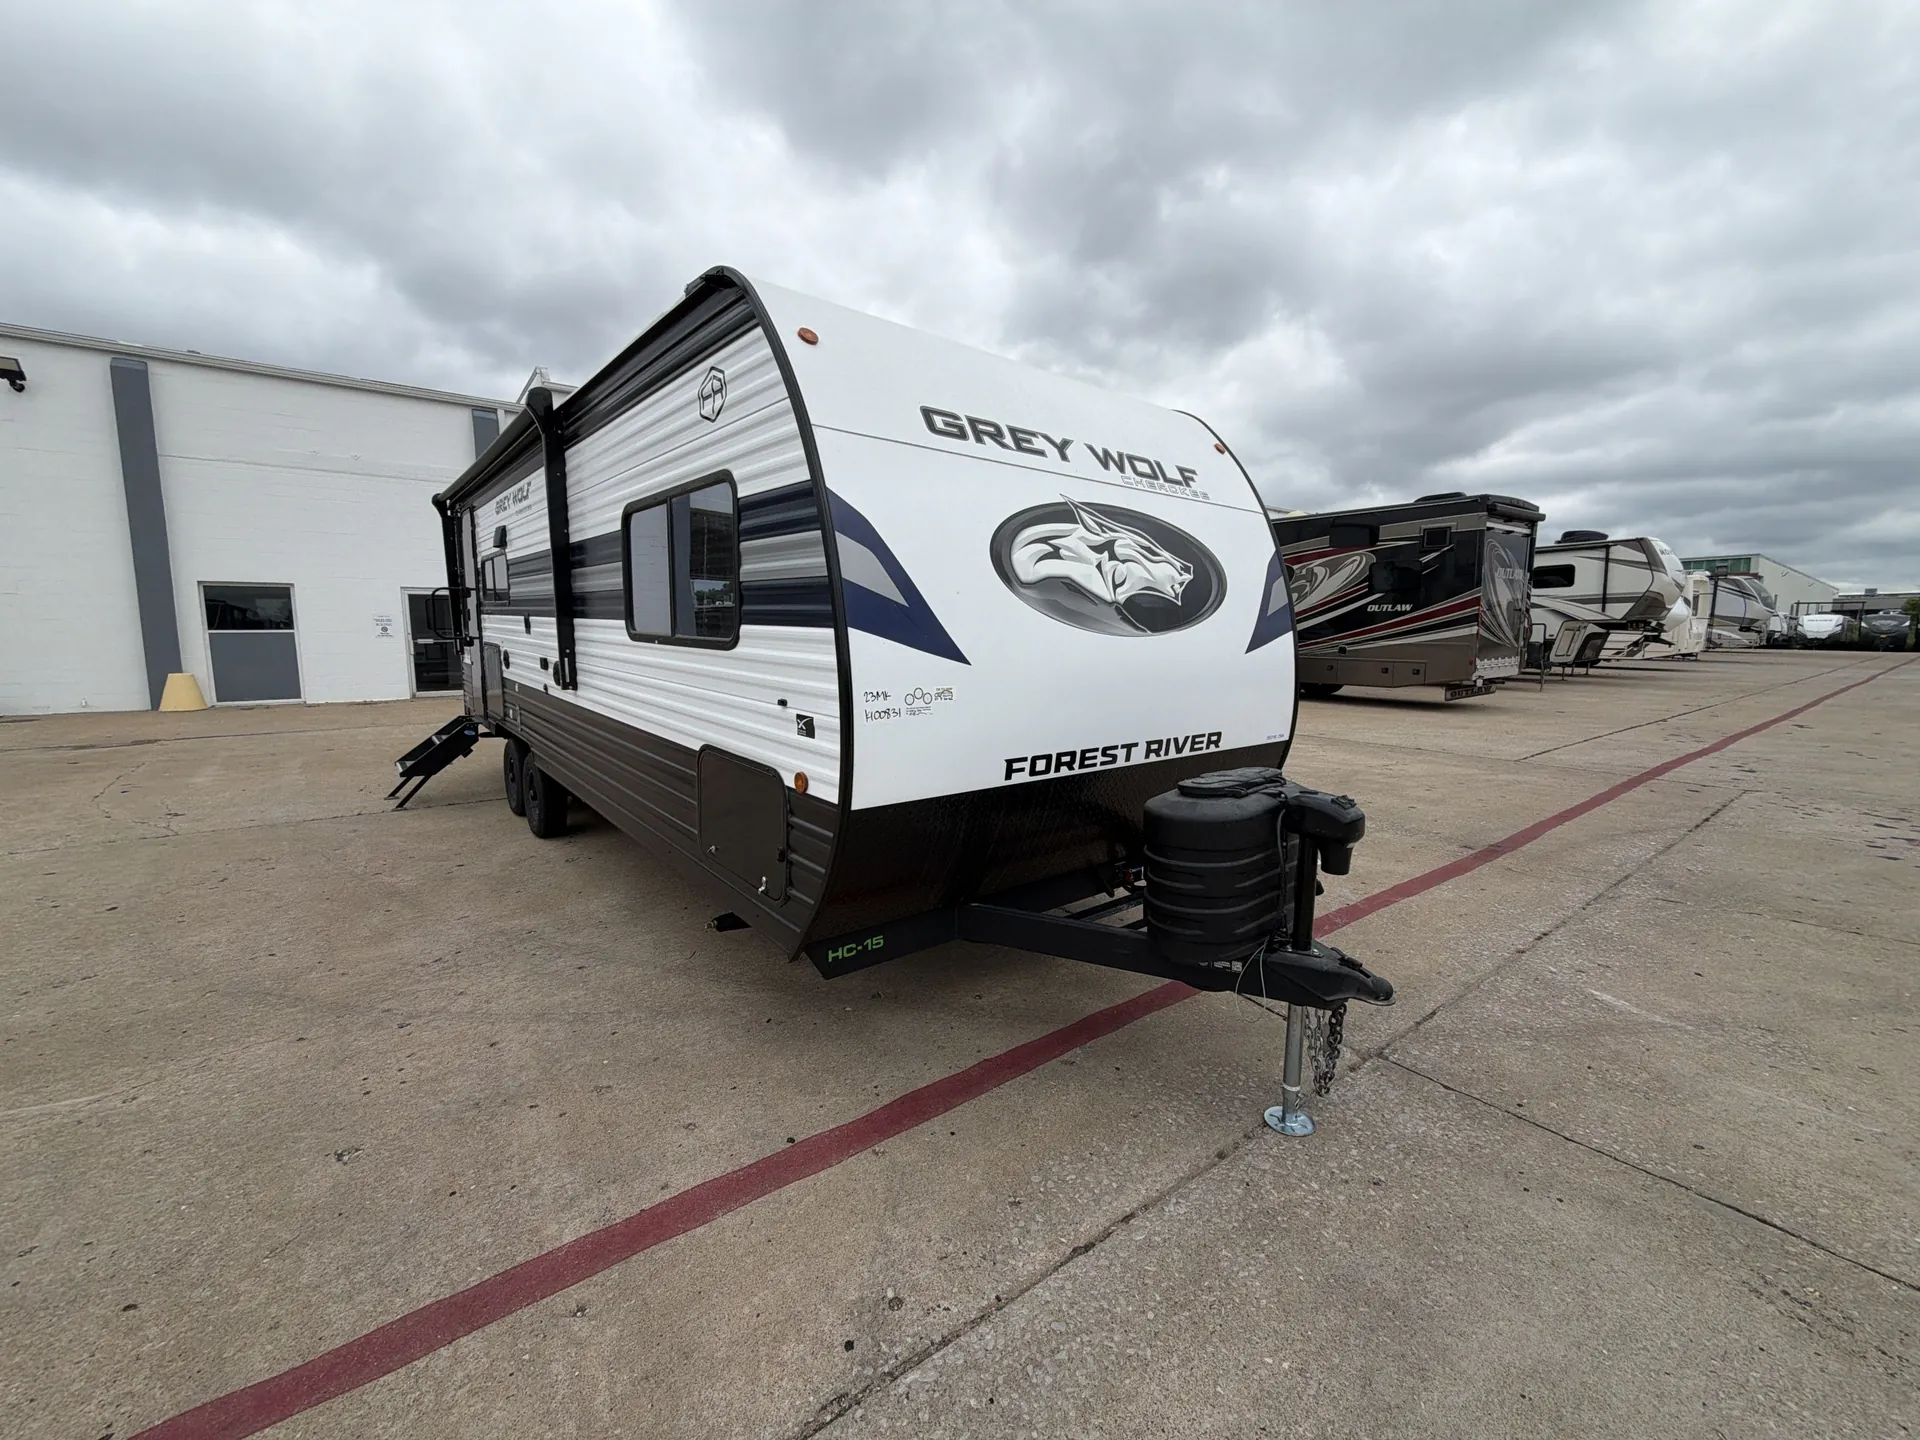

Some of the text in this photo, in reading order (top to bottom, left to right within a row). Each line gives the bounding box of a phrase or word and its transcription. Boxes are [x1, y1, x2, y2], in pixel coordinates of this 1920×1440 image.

[919, 405, 1199, 489] GREY WOLF
[1120, 475, 1211, 501] CHEROKEE
[1366, 603, 1414, 612] OUTLAW
[1004, 731, 1222, 781] FOREST RIVER
[827, 935, 884, 963] HC-15
